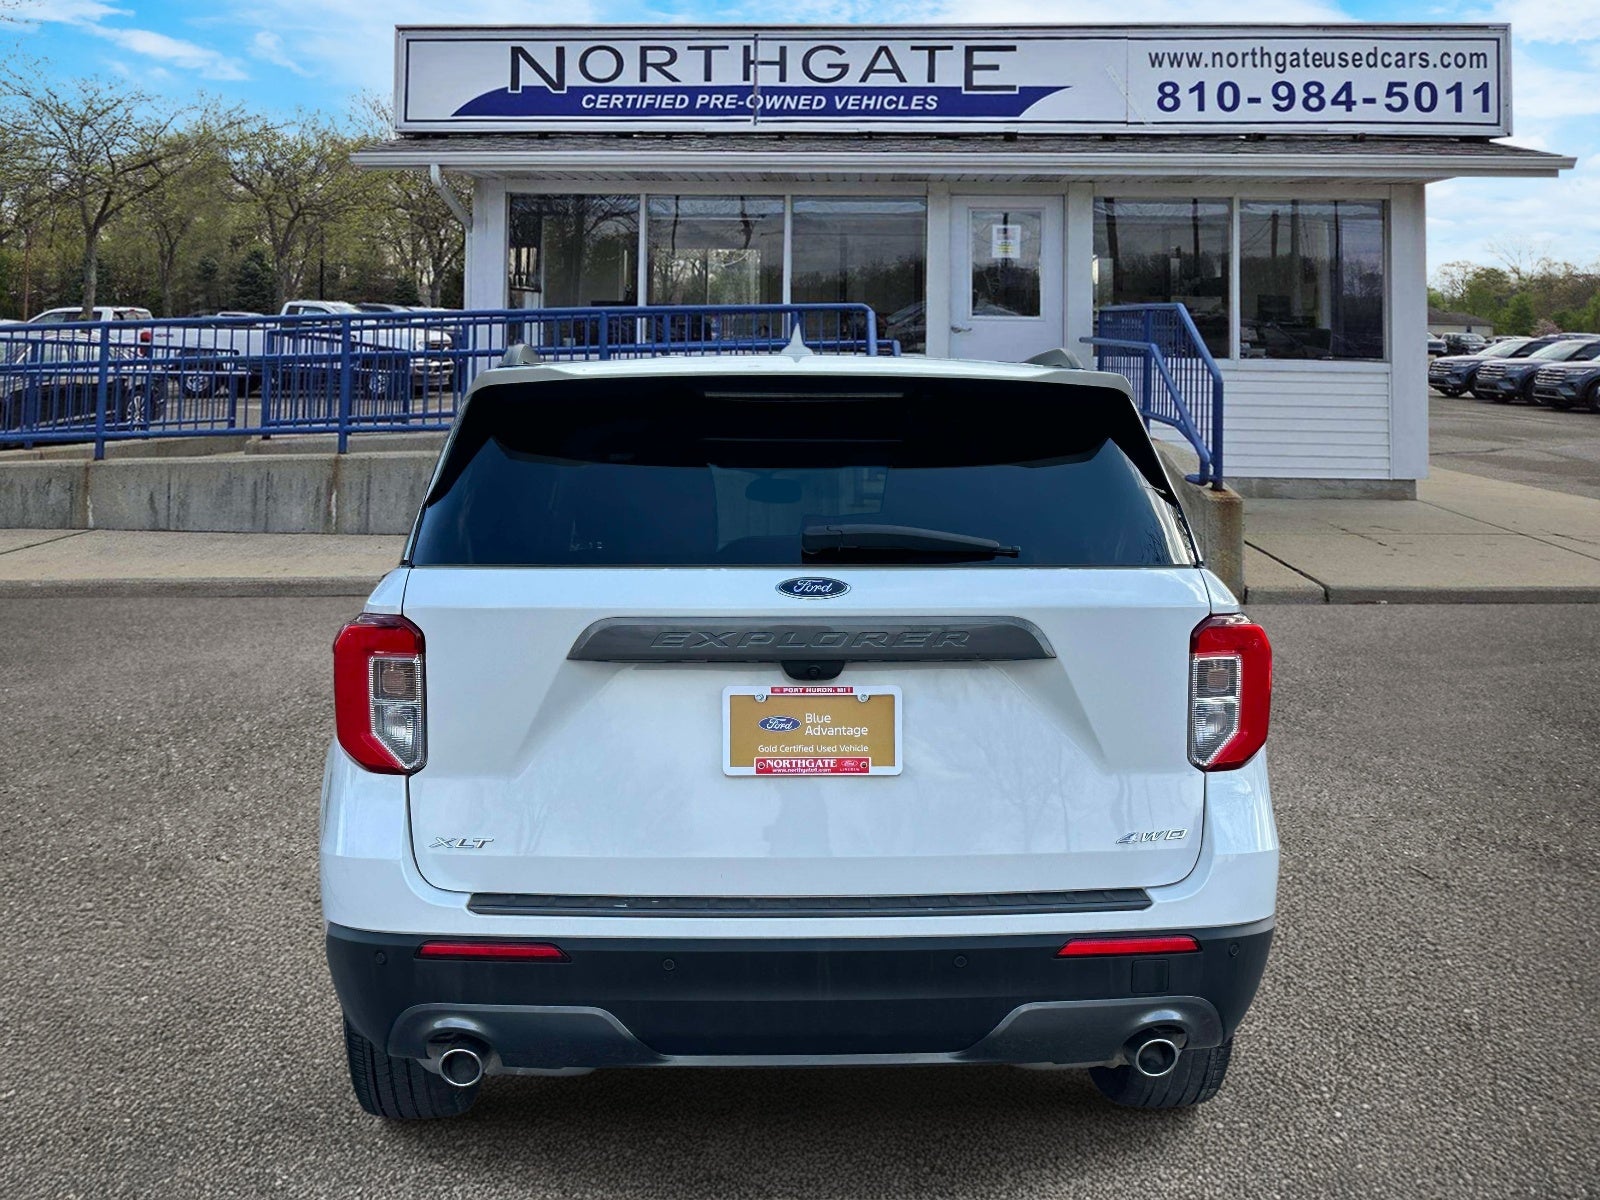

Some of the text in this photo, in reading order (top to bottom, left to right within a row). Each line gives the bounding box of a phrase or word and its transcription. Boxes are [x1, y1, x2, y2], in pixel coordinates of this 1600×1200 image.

[1148, 46, 1489, 74] www.northgateusedcars.com
[509, 45, 1018, 92] NORTHGATE
[581, 94, 939, 111] CERTIFIED PRE-OWNED VEHICLES
[1156, 80, 1492, 114] 810-984-5011
[793, 579, 833, 593] Ford
[649, 631, 971, 649] EXPLORER
[766, 719, 793, 730] Ford
[805, 713, 832, 723] Blue
[805, 725, 868, 737] Advantage
[766, 759, 837, 768] NORTHGATE
[428, 836, 495, 849] XLT
[1115, 829, 1187, 844] 4WD
